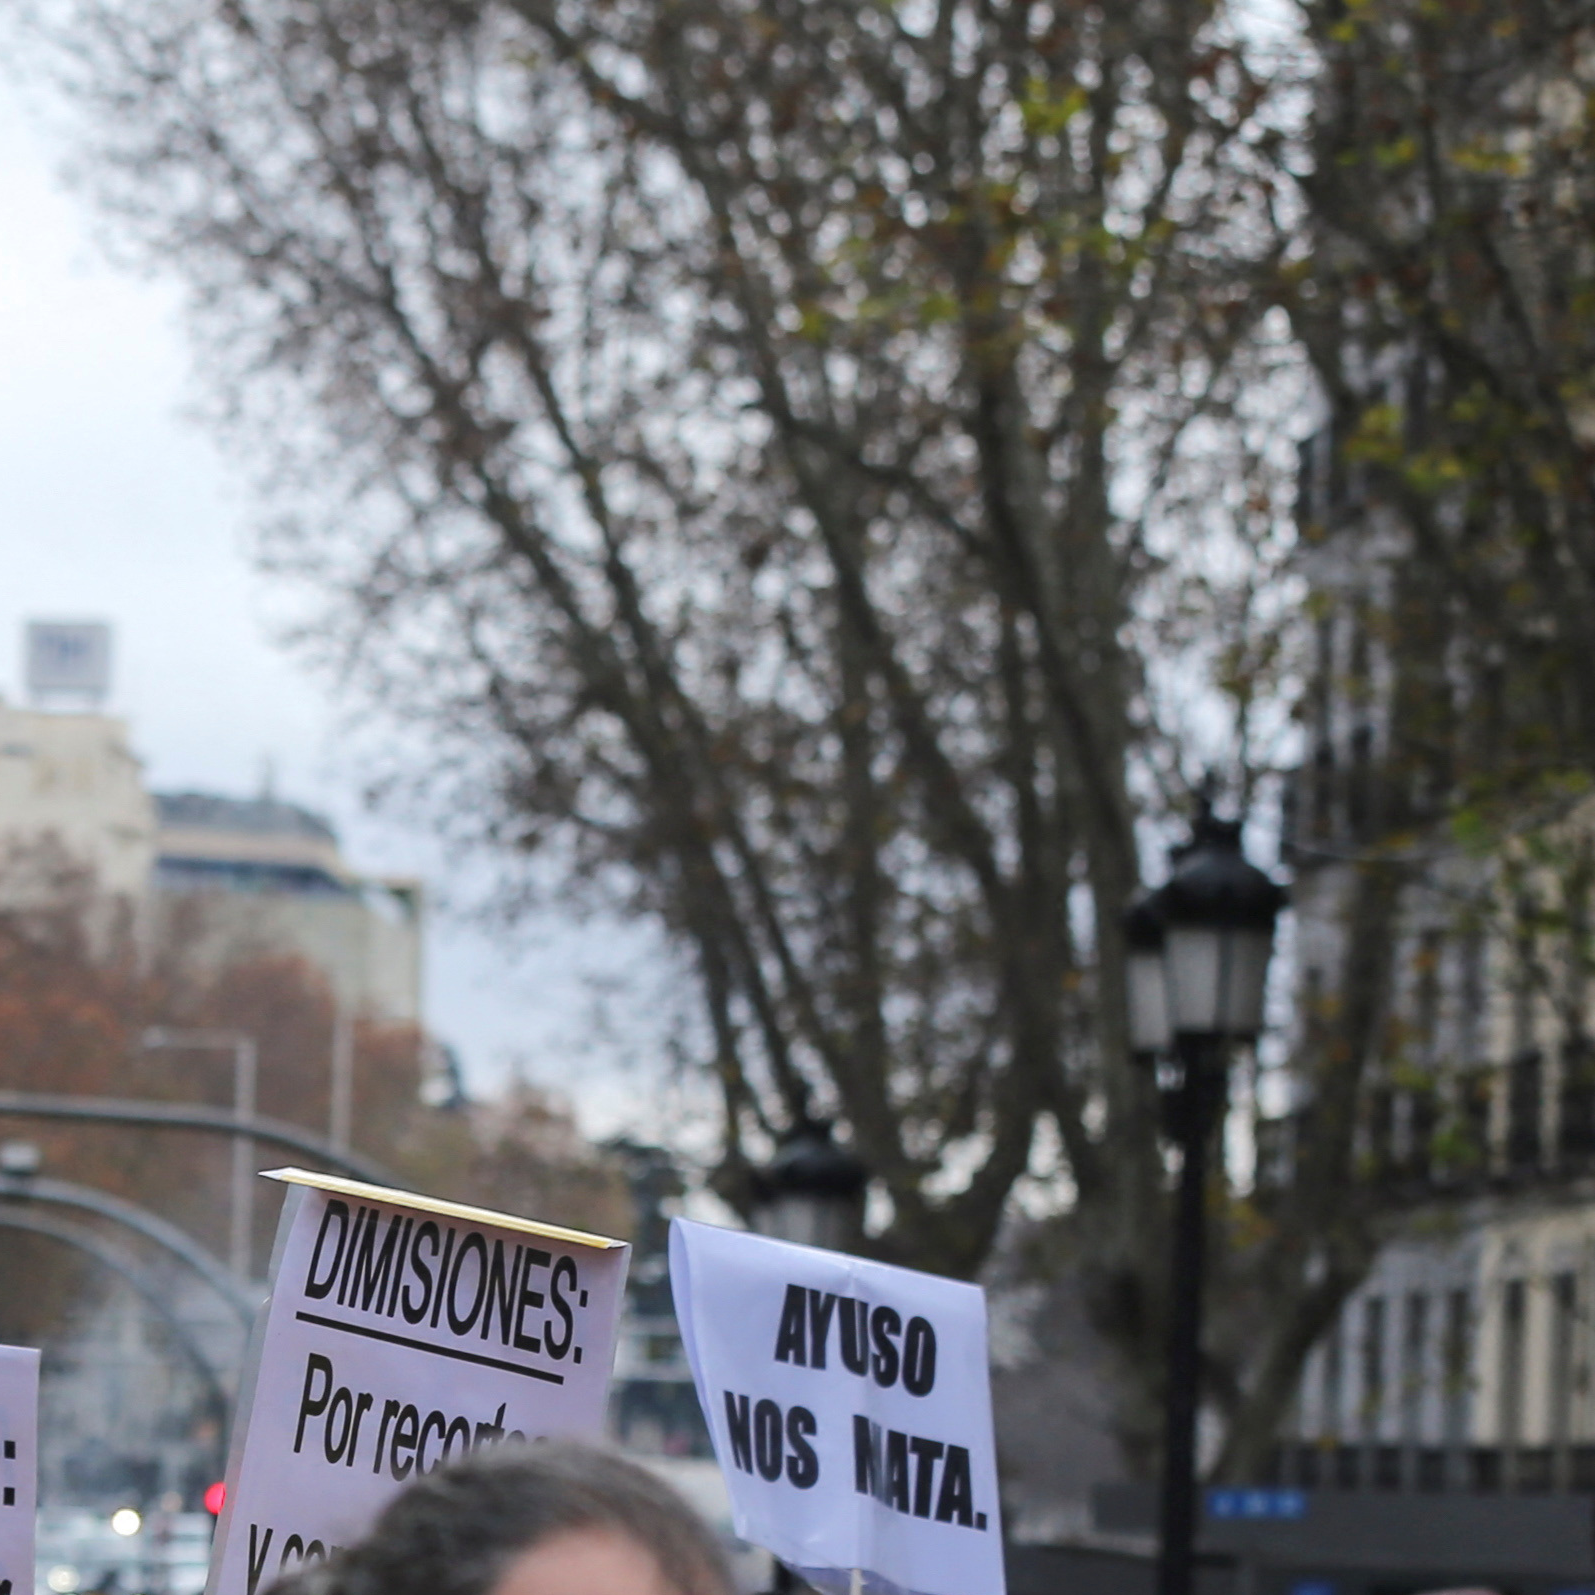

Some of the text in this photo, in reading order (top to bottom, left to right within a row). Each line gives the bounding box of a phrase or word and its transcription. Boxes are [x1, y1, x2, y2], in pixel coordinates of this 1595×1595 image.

[305, 1198, 588, 1364] DIMISIONES:
[773, 1285, 937, 1398] AYUSO
[293, 1352, 374, 1468] Por
[723, 1390, 820, 1490] NOS
